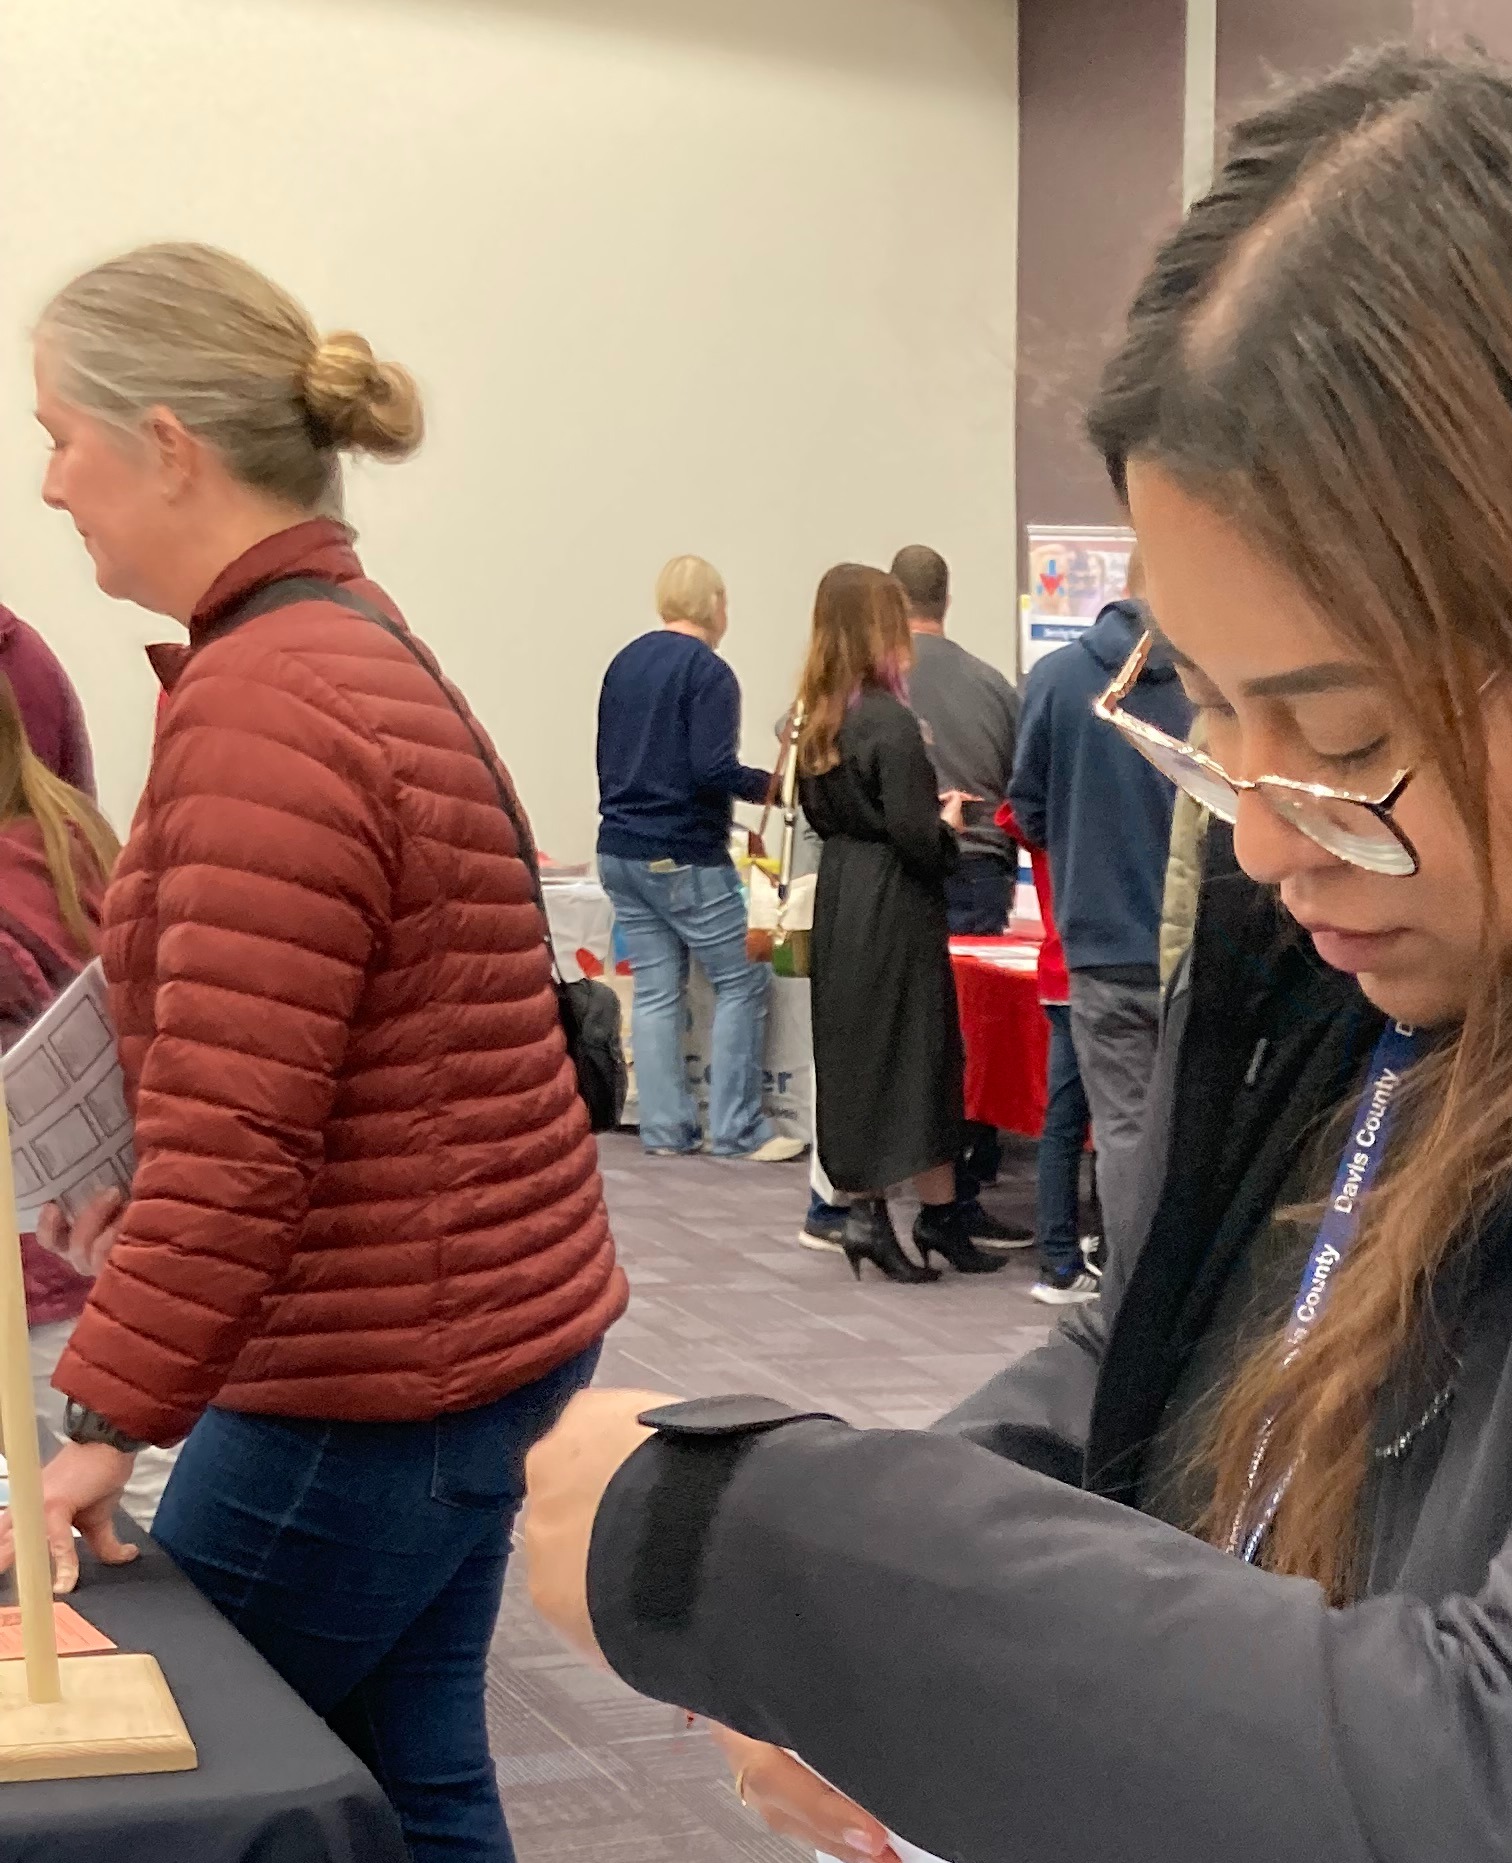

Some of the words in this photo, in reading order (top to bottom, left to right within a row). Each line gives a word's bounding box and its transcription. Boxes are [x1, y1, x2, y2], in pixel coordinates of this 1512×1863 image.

[1334, 1152, 1369, 1214] Davis
[1355, 1068, 1399, 1148] County
[1296, 1243, 1341, 1322] County
